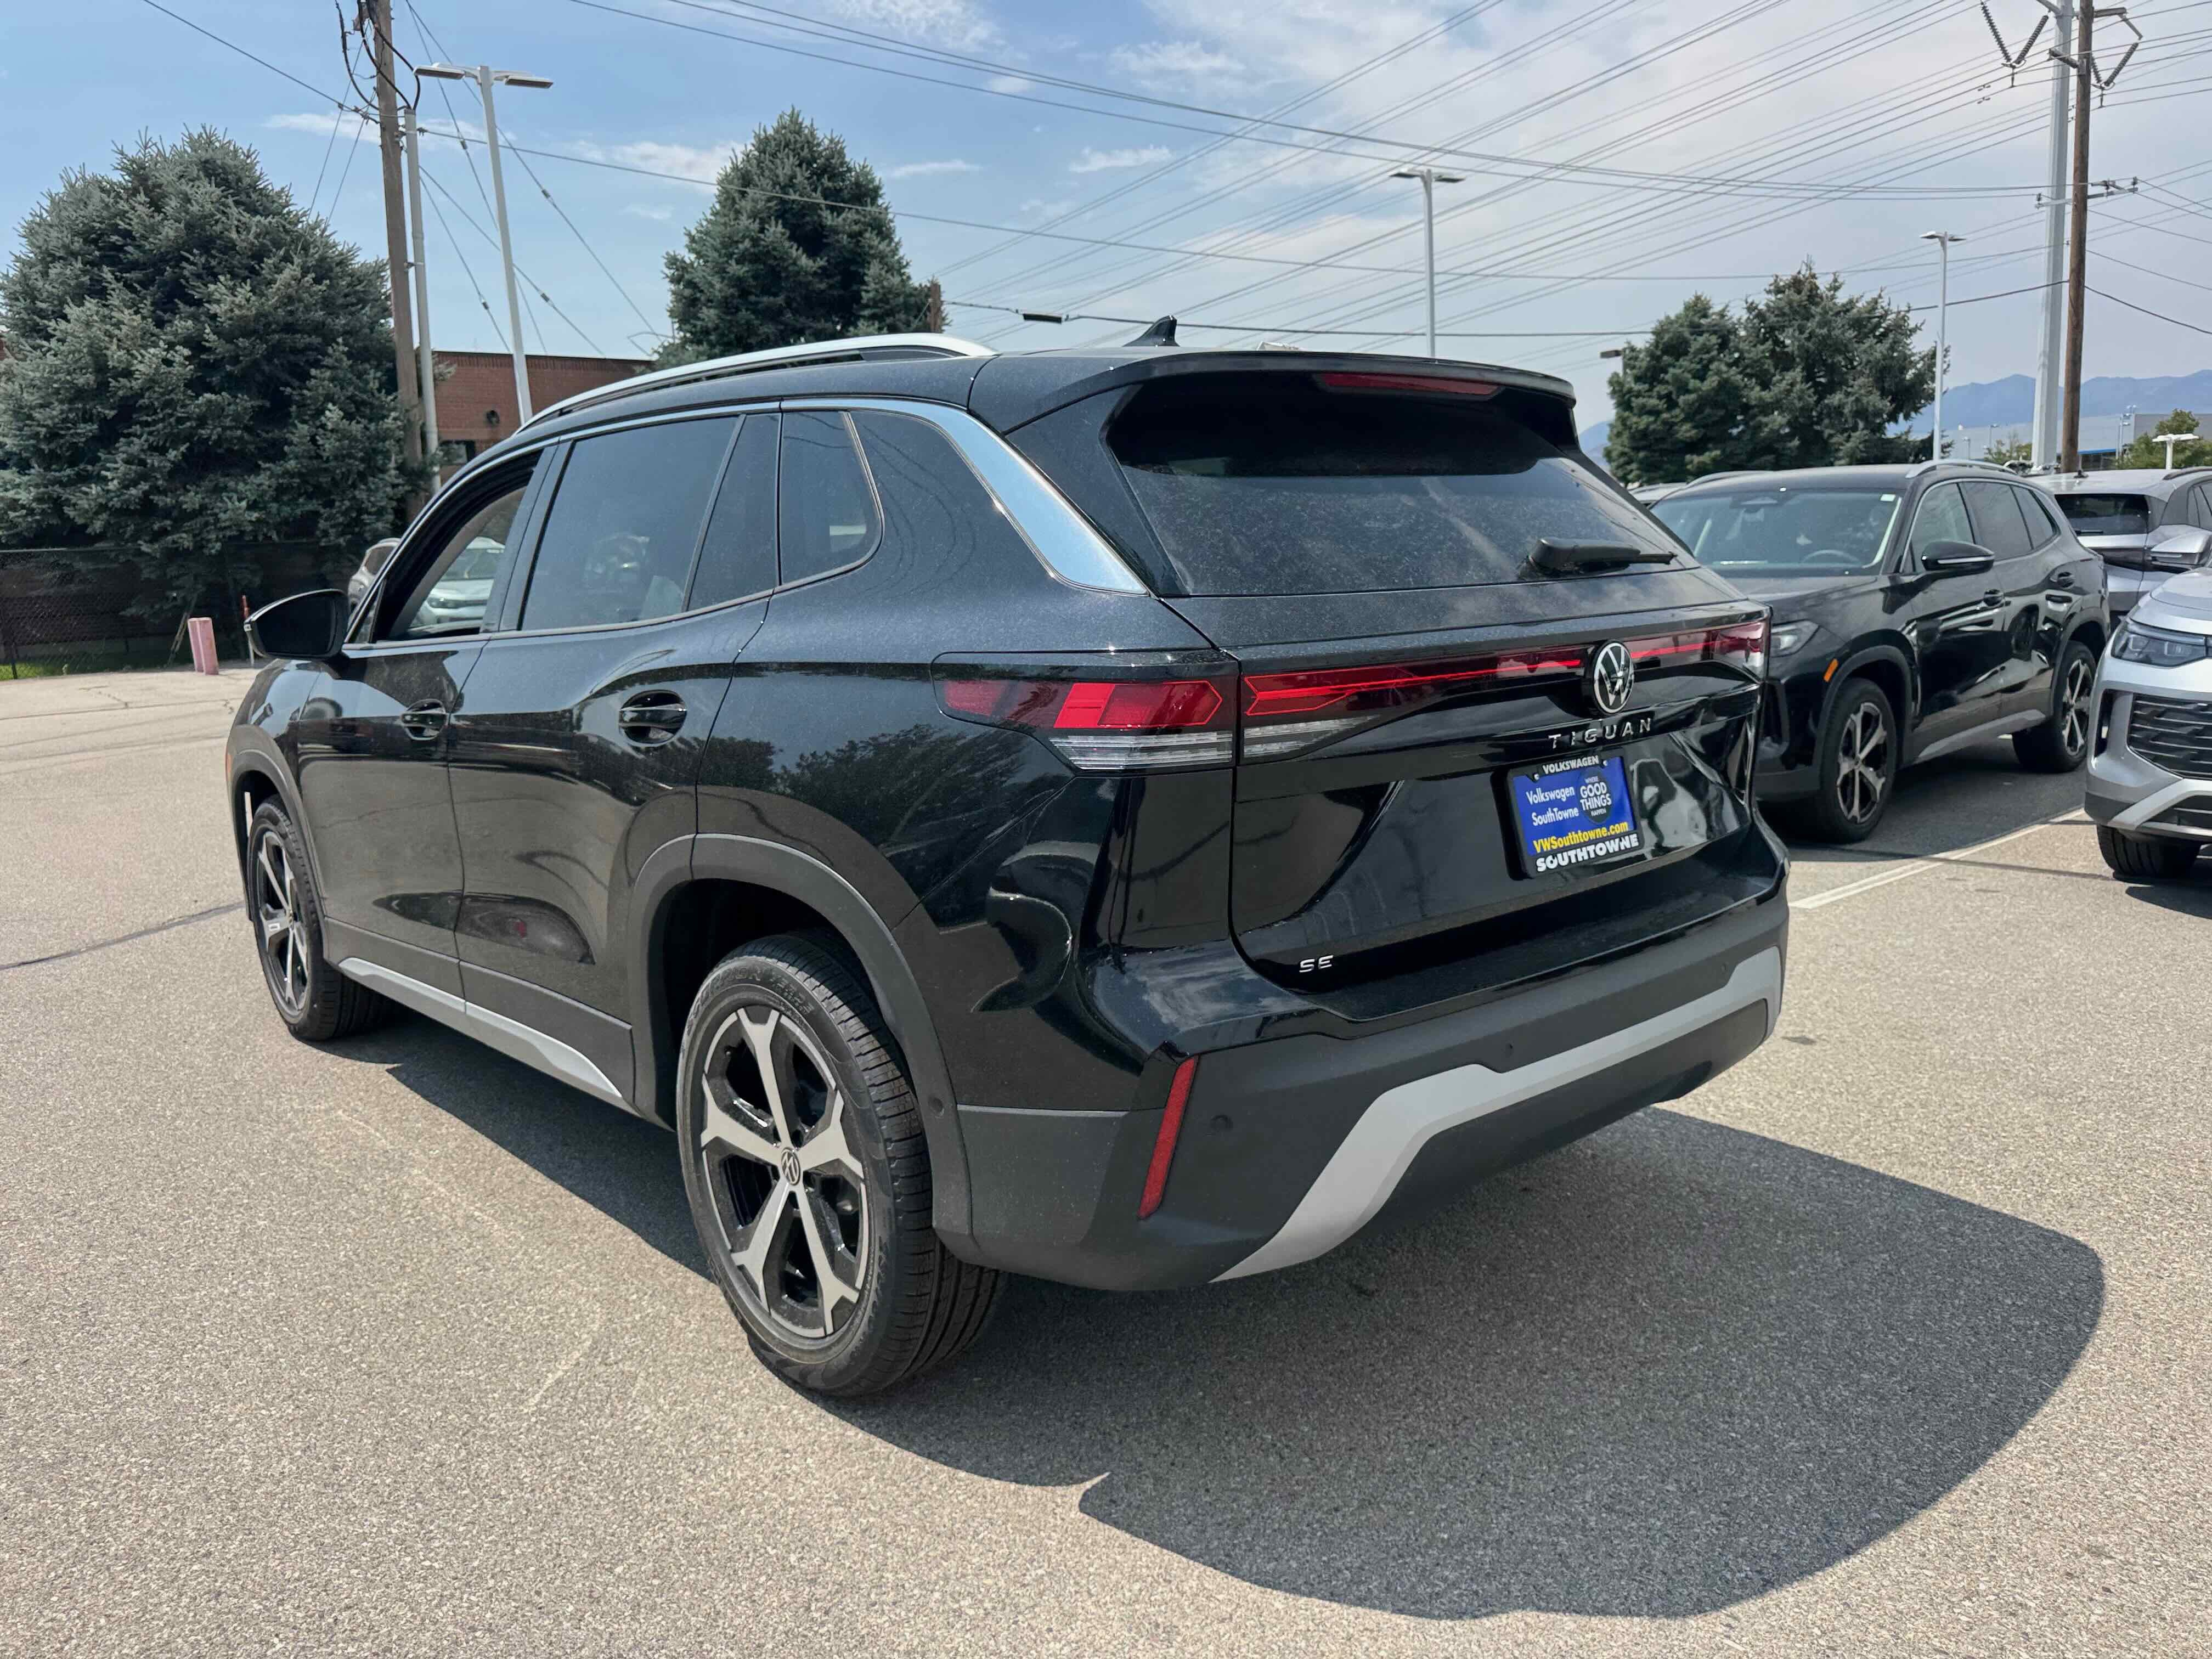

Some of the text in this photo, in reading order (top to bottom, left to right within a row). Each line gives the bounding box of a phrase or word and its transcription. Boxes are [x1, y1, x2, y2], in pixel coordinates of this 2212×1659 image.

[1548, 718, 1650, 749] TIGUAN
[1542, 755, 1599, 775] VOLKSWAGEN
[1526, 786, 1575, 805] Volkswagen
[1580, 782, 1607, 798] GOOD
[1580, 793, 1612, 811] THINGS
[1532, 807, 1579, 826] SouthTowne
[1533, 822, 1629, 853] VWSouthtowne.com
[1536, 833, 1639, 872] SOUTHTOWNE
[1299, 955, 1334, 973] SE
